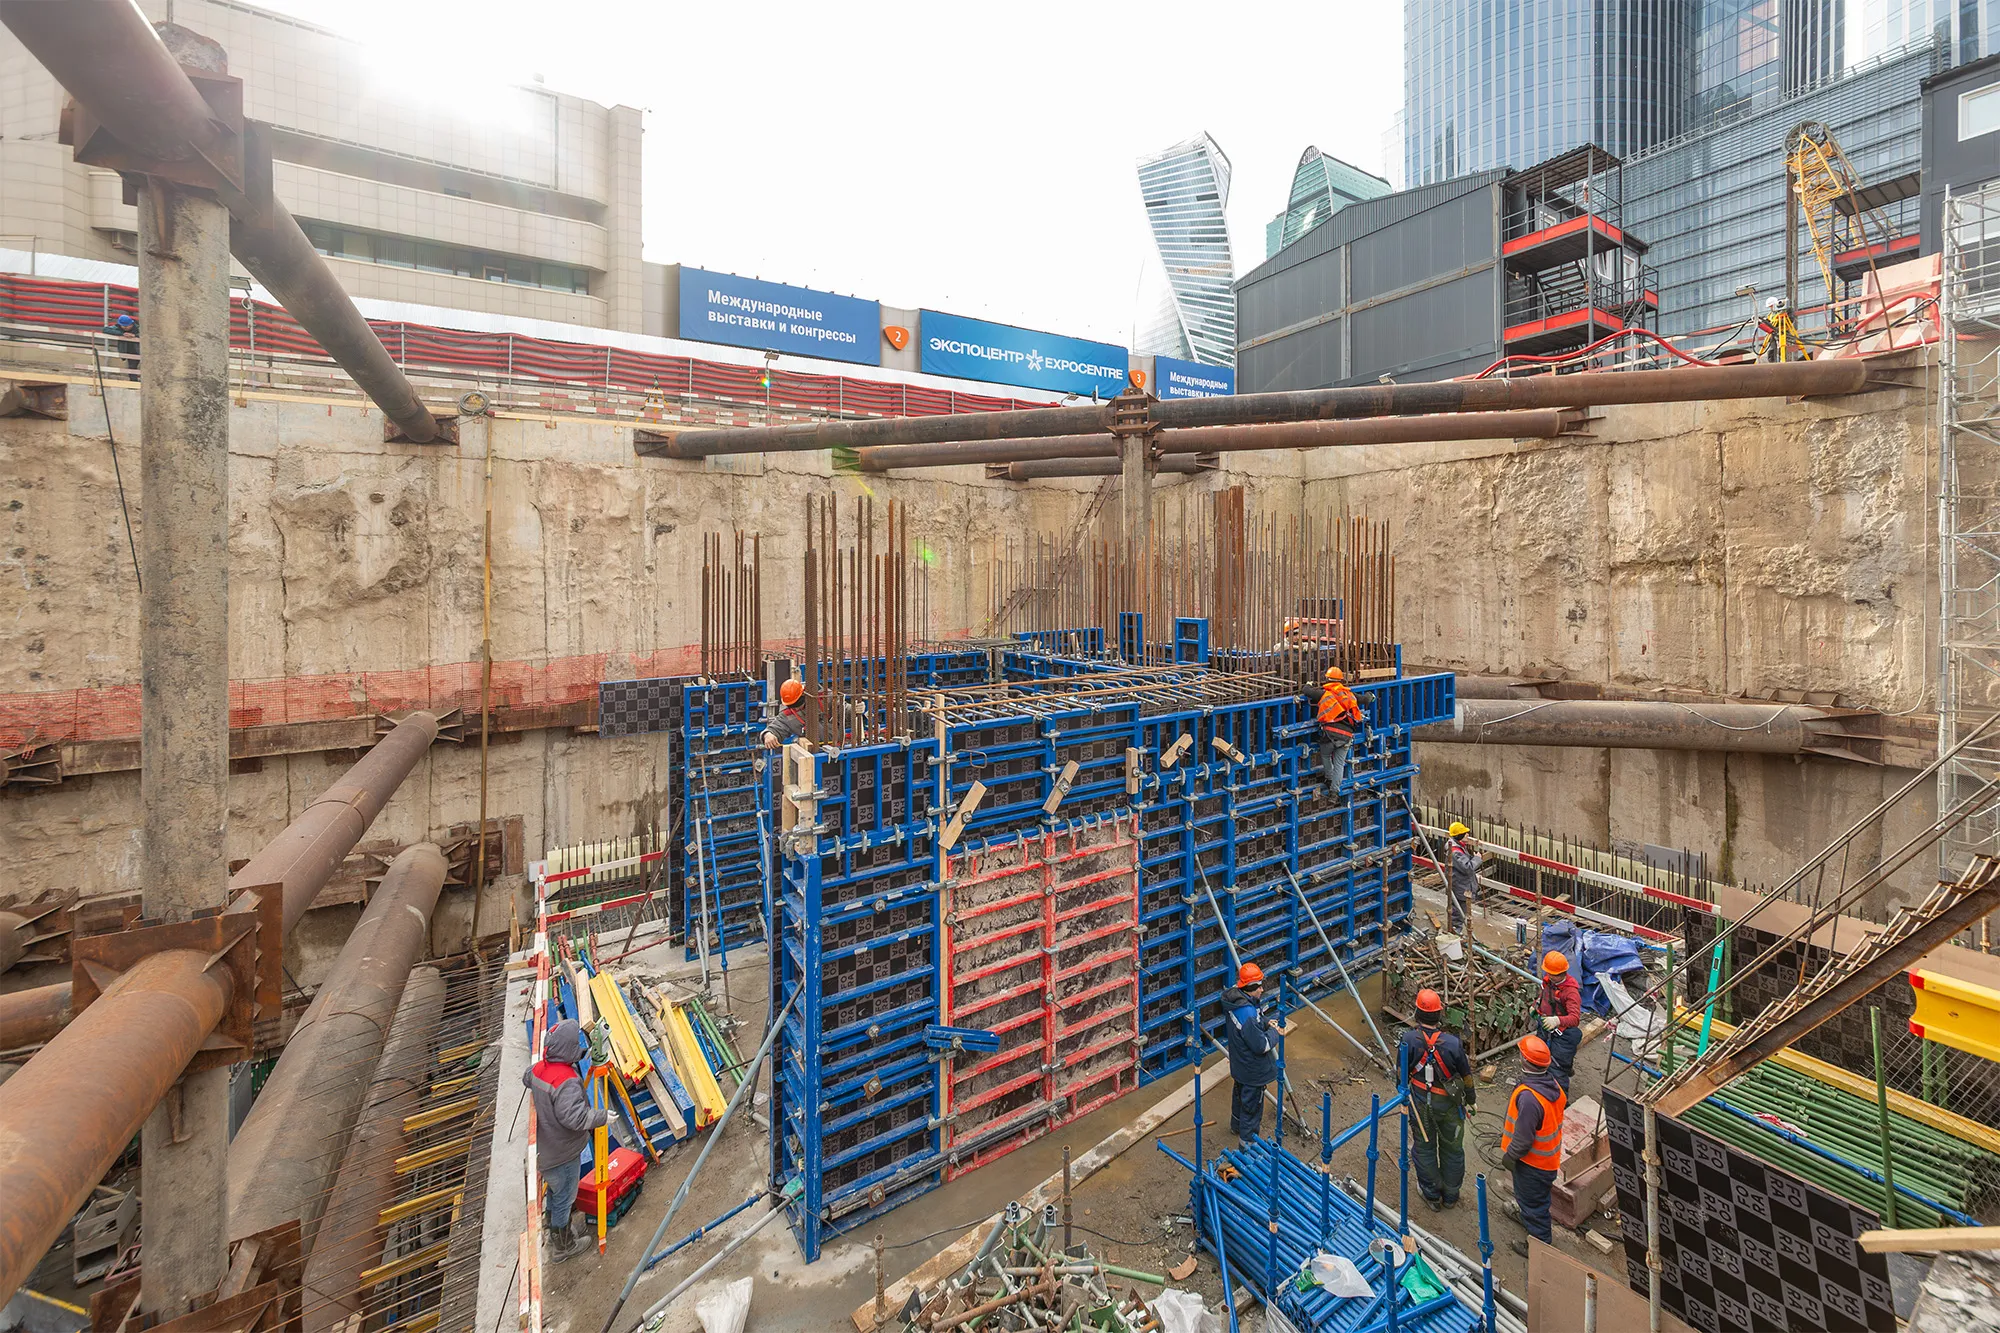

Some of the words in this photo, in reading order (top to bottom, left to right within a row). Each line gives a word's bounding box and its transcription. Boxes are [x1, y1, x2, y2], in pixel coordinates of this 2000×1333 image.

[708, 289, 823, 322] Международные
[708, 310, 776, 331] выставки
[779, 322, 787, 333] и
[790, 322, 856, 344] конгрессы
[895, 331, 902, 342] 2
[929, 337, 1024, 364] ЭКСПОЦЕНТР
[1045, 357, 1123, 380] EXPOCENTRE
[1136, 373, 1142, 383] 3
[1169, 386, 1204, 398] выставки
[1170, 371, 1228, 390] Международные
[1606, 1120, 1616, 1139] FO
[1619, 1126, 1630, 1144] RA
[1666, 1149, 1680, 1171] FO
[1696, 1140, 1708, 1160] RA
[1709, 1145, 1724, 1170] FO
[1613, 1166, 1623, 1186] FO
[1680, 1159, 1693, 1178] RA
[1625, 1173, 1636, 1193] RA
[1770, 1176, 1785, 1199] RA
[1704, 1192, 1717, 1213] RA
[1736, 1185, 1750, 1208] FO
[1752, 1194, 1766, 1216] RA
[1786, 1183, 1803, 1208] FO
[1675, 1200, 1686, 1221] FO
[1687, 1209, 1700, 1229] RA
[1719, 1199, 1732, 1223] FO
[1620, 1214, 1630, 1232] FO
[1633, 1221, 1643, 1240] RA
[1778, 1231, 1793, 1255] RA
[1816, 1225, 1833, 1251] FO
[1833, 1235, 1852, 1260] RA
[1681, 1250, 1694, 1273] FO
[1710, 1243, 1725, 1265] RA
[1743, 1238, 1759, 1263] FO
[1760, 1248, 1775, 1271] RA
[1794, 1240, 1811, 1265] FO
[1627, 1261, 1639, 1280] FO
[1696, 1259, 1708, 1280] RA
[1725, 1250, 1740, 1275] FO
[1787, 1286, 1802, 1310] RA
[1825, 1283, 1842, 1309] FO
[1866, 1278, 1884, 1303] RA
[1689, 1300, 1702, 1323] FO
[1719, 1295, 1733, 1317] RA
[1733, 1303, 1748, 1327] FO
[1752, 1291, 1767, 1317] FO
[1769, 1303, 1784, 1326] RA
[1803, 1295, 1820, 1321] FO
[1843, 1294, 1861, 1320] RA
[1703, 1310, 1716, 1331] RA
